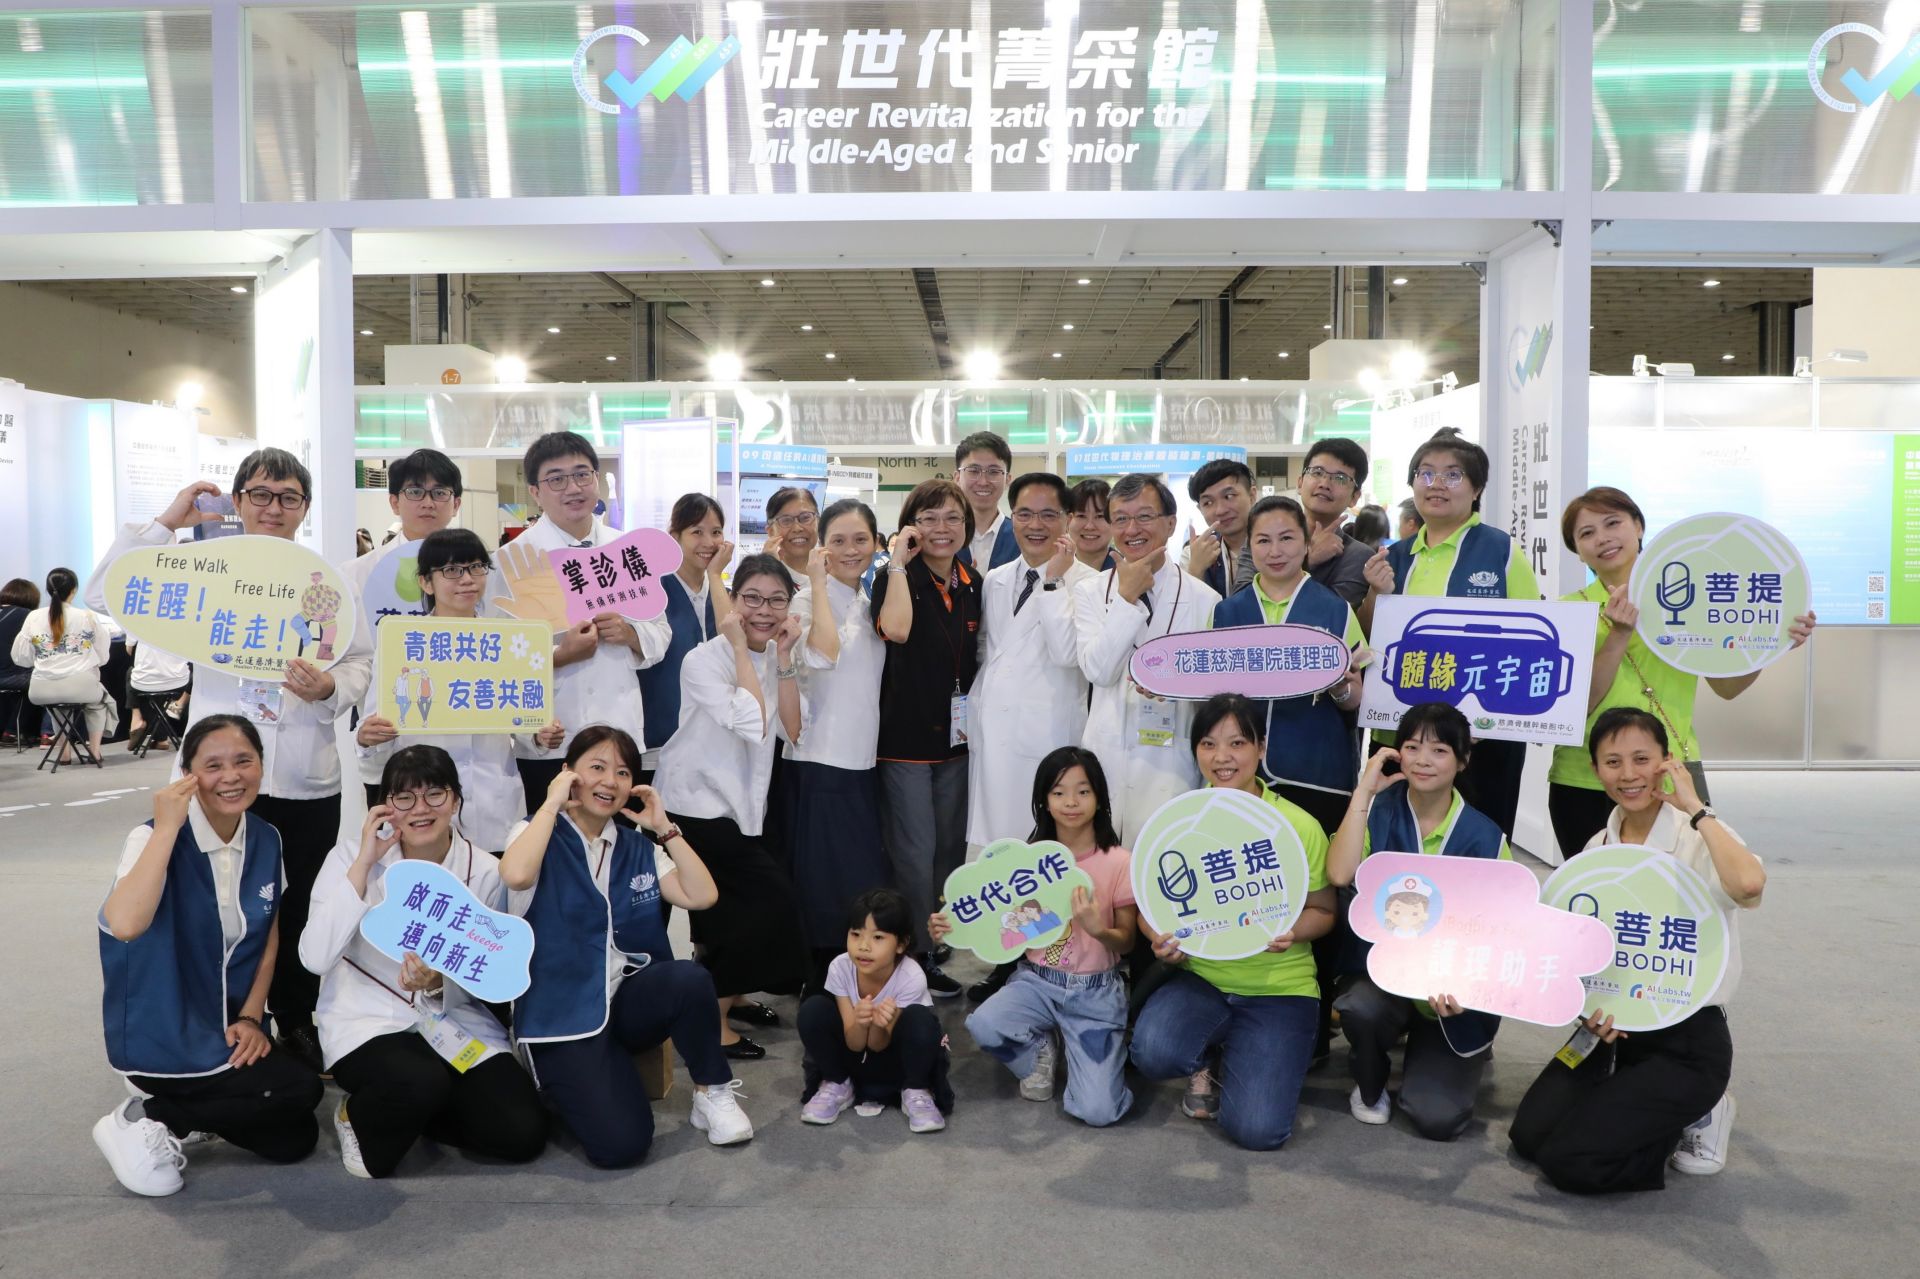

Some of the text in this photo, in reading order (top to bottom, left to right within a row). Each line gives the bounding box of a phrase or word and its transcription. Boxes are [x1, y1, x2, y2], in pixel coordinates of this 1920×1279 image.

[759, 27, 1219, 89] 壯世代菁采館
[758, 102, 859, 128] Career
[867, 102, 1087, 128] Revitalzatin
[1096, 102, 1144, 128] for
[748, 138, 956, 172] Middle-Aged
[443, 373, 459, 384] 1-7
[878, 457, 917, 468] North
[924, 457, 938, 468] 北
[1532, 422, 1549, 600] 壯世代
[156, 552, 229, 575] Free Walk
[561, 545, 652, 595] 掌診儀
[122, 575, 207, 622] 能醒！
[234, 579, 296, 600] Free Life
[1705, 572, 1783, 603] 菩提
[209, 608, 287, 651] 能走！
[1707, 609, 1779, 624] BODHI
[404, 631, 502, 663] 青銀共好
[1748, 635, 1779, 643] Labs.tw
[235, 655, 289, 668] 花蓮慈濟醫
[1174, 644, 1340, 675] 花蓮慈濟醫院護理部
[1400, 650, 1554, 698] 髓緣元宇宙
[448, 679, 545, 710] 友善共融
[1366, 708, 1390, 721] Stem
[1200, 838, 1281, 884] 菩提
[951, 852, 1070, 924] 世代合作
[1214, 875, 1285, 905] BODHI
[402, 881, 472, 932] 啟而走
[1260, 903, 1289, 914] Labs.tw
[465, 928, 504, 952] keeogo
[1614, 910, 1698, 954] 菩提
[397, 920, 488, 983] 邁向新生
[1428, 937, 1561, 993] 護理助手
[1615, 950, 1694, 977] BODHI
[1658, 986, 1692, 997] Labs.tw
